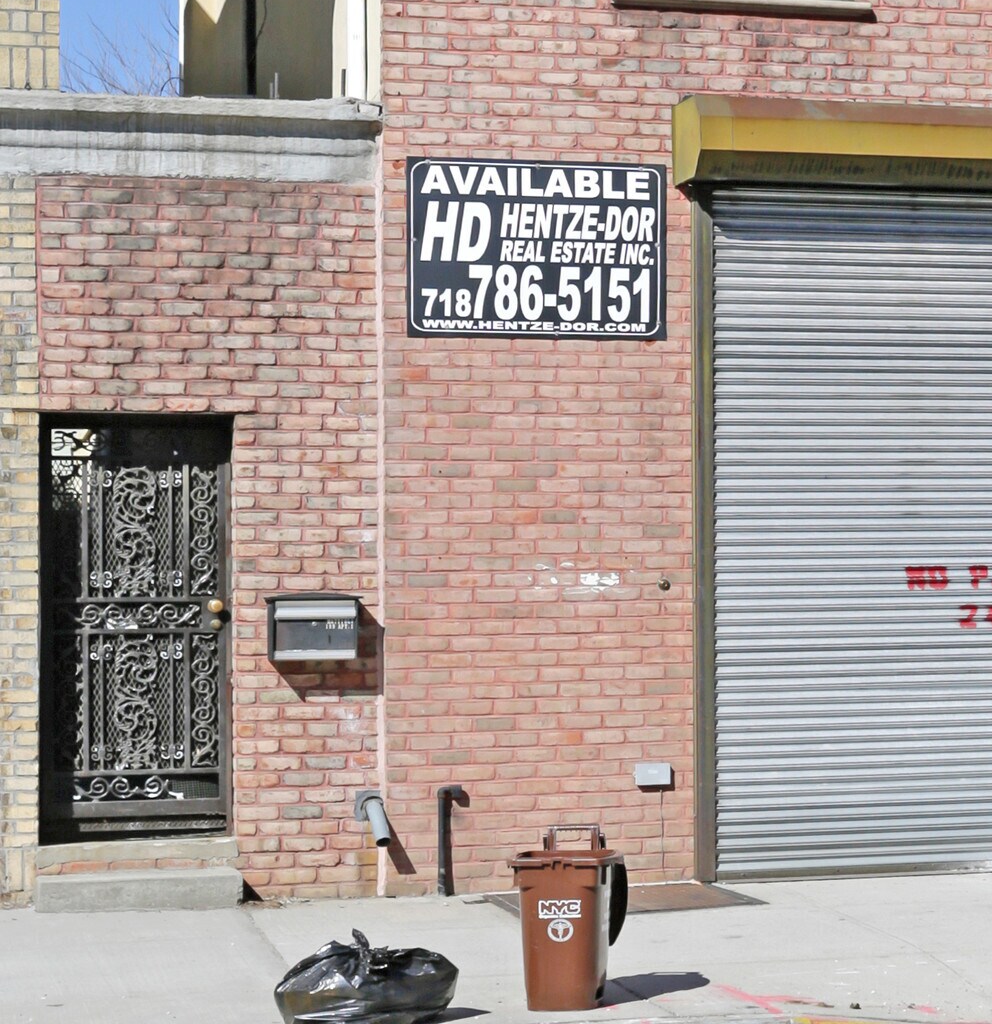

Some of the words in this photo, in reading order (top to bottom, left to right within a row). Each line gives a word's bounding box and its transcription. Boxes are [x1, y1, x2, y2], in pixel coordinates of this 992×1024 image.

[421, 165, 650, 200] AVAILABLE
[420, 201, 492, 262] HD
[500, 203, 656, 242] HENTZE-DOR
[500, 241, 546, 263] REAL
[550, 243, 615, 264] ESTATE
[619, 245, 655, 266] INC.
[421, 288, 471, 318] 718
[469, 264, 650, 323] 786-5151
[422, 319, 647, 333] WWW.HENTZE-DOR.COM
[905, 566, 949, 590] NO
[538, 900, 582, 915] NYC
